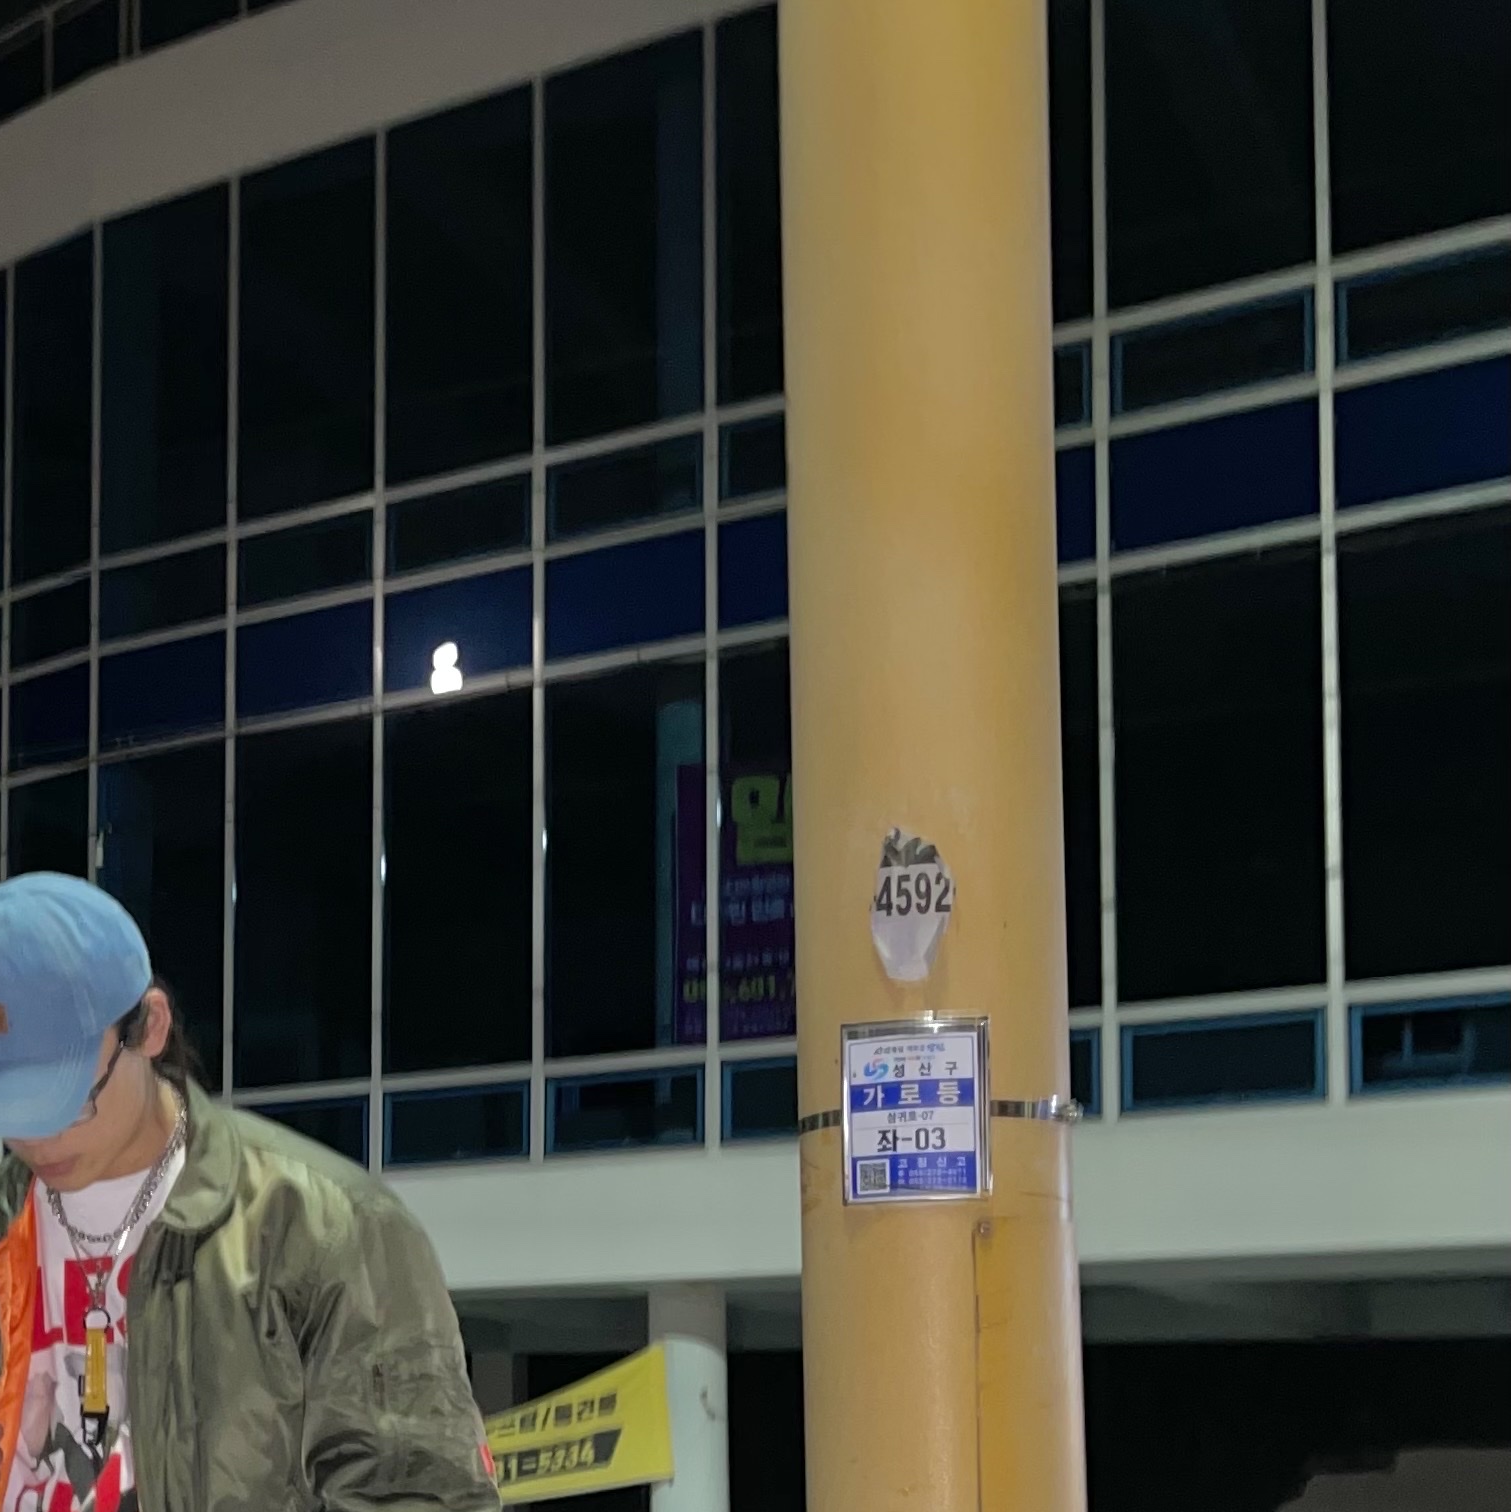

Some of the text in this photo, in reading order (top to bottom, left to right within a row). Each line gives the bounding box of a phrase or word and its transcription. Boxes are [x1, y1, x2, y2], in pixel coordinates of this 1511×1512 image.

[875, 871, 952, 917] 4592
[863, 1081, 961, 1109] 가로등
[876, 1127, 947, 1153] 좌-03
